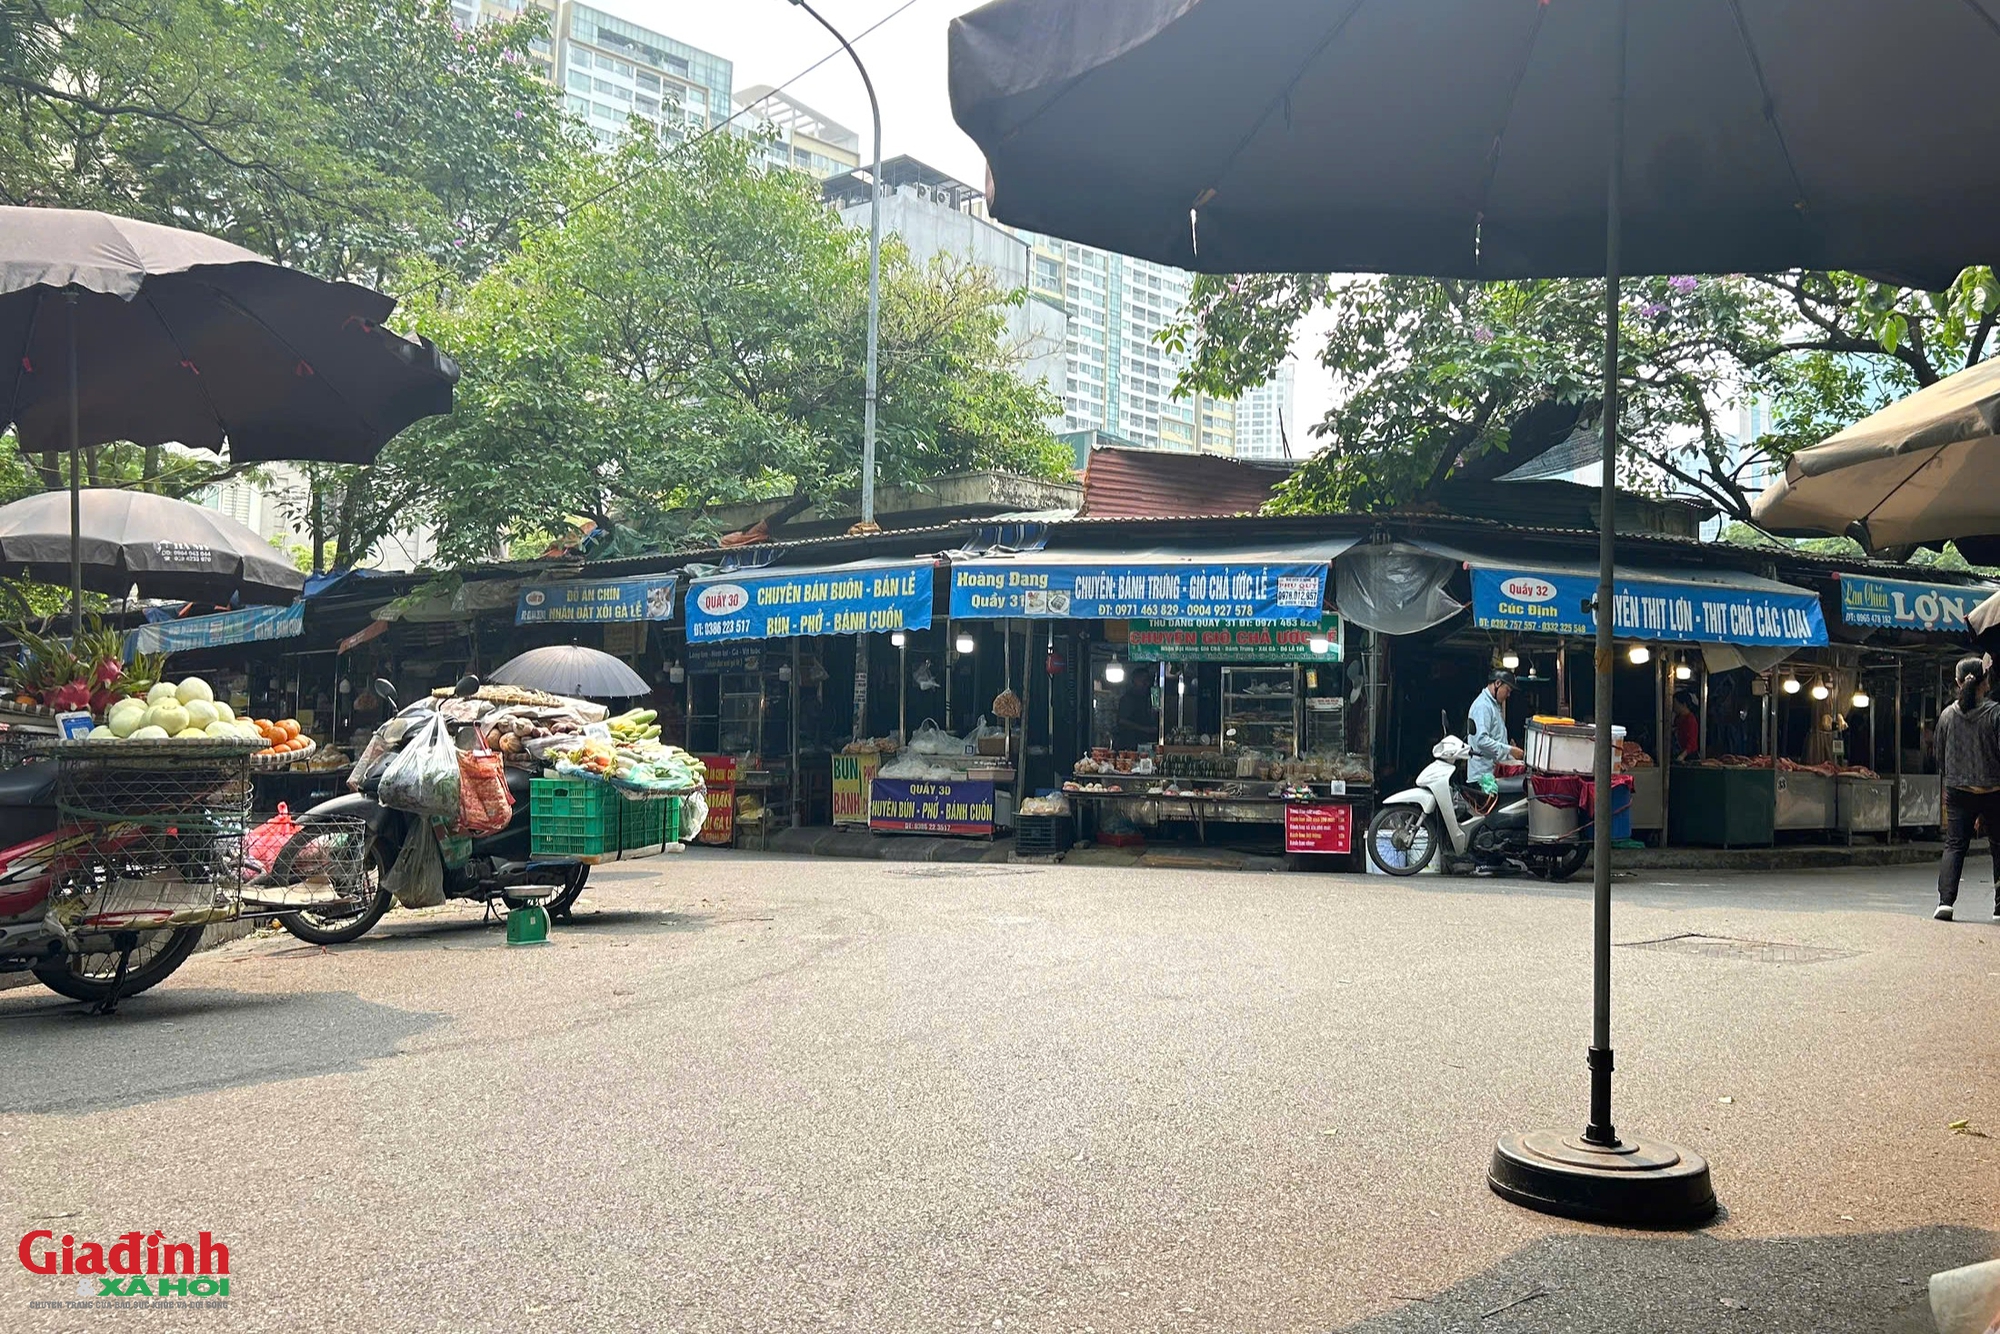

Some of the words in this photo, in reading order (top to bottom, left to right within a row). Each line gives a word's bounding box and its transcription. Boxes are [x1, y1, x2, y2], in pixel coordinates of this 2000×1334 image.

[757, 581, 801, 606] CHUYÊN
[804, 580, 828, 603] BÁN
[831, 578, 863, 601] BUÔN
[874, 575, 899, 597] BÁN
[902, 570, 915, 596] LẺ
[957, 571, 1005, 589] Hoàng
[1075, 571, 1116, 599] CHUYÊN:
[1118, 570, 1145, 599] BÁNH
[1189, 569, 1207, 600] GIÒ
[1209, 567, 1229, 600] CHẢ
[1232, 570, 1253, 600] ƯỚC
[1255, 567, 1268, 600] LỄ
[597, 586, 620, 602] CHÍN
[728, 594, 739, 606] 30
[971, 592, 1005, 608] Quầy
[1010, 594, 1025, 607] 31
[1536, 586, 1548, 596] 32
[596, 603, 612, 619] XÔI
[615, 601, 628, 618] GÀ
[630, 599, 642, 618] LỄ
[1115, 604, 1137, 615] 0971
[1141, 604, 1158, 615] 463
[1161, 604, 1179, 616] 829
[1187, 604, 1211, 616] 0904
[1214, 604, 1232, 616] 927
[1235, 604, 1253, 616] 578
[1498, 602, 1524, 615] Cúc
[1528, 604, 1558, 618] Định
[1891, 590, 1965, 629] LỢN
[705, 621, 721, 635] 0386
[722, 620, 735, 634] 223
[736, 618, 751, 633] 517
[767, 611, 790, 635] BÚN
[801, 608, 824, 633] PHỞ
[834, 609, 866, 631] BÁNH
[870, 602, 903, 629] CUỐN
[1524, 621, 1536, 630] 557
[1641, 596, 1666, 637] THỊT
[1669, 596, 1693, 638] LỢN
[1703, 602, 1727, 642] THỊT
[1730, 599, 1754, 636] CHÓ
[1756, 600, 1780, 638] CÁC
[1782, 608, 1812, 645] LOẠI
[1129, 628, 1197, 645] CHUYÊN
[1202, 628, 1232, 645] GIÒ
[1236, 627, 1271, 645] CHẢ
[834, 787, 860, 815] BÁNH
[898, 797, 915, 818] BÚN
[922, 796, 939, 819] PHỞ
[946, 800, 968, 820] BÁNH
[970, 797, 993, 820] CUỐN
